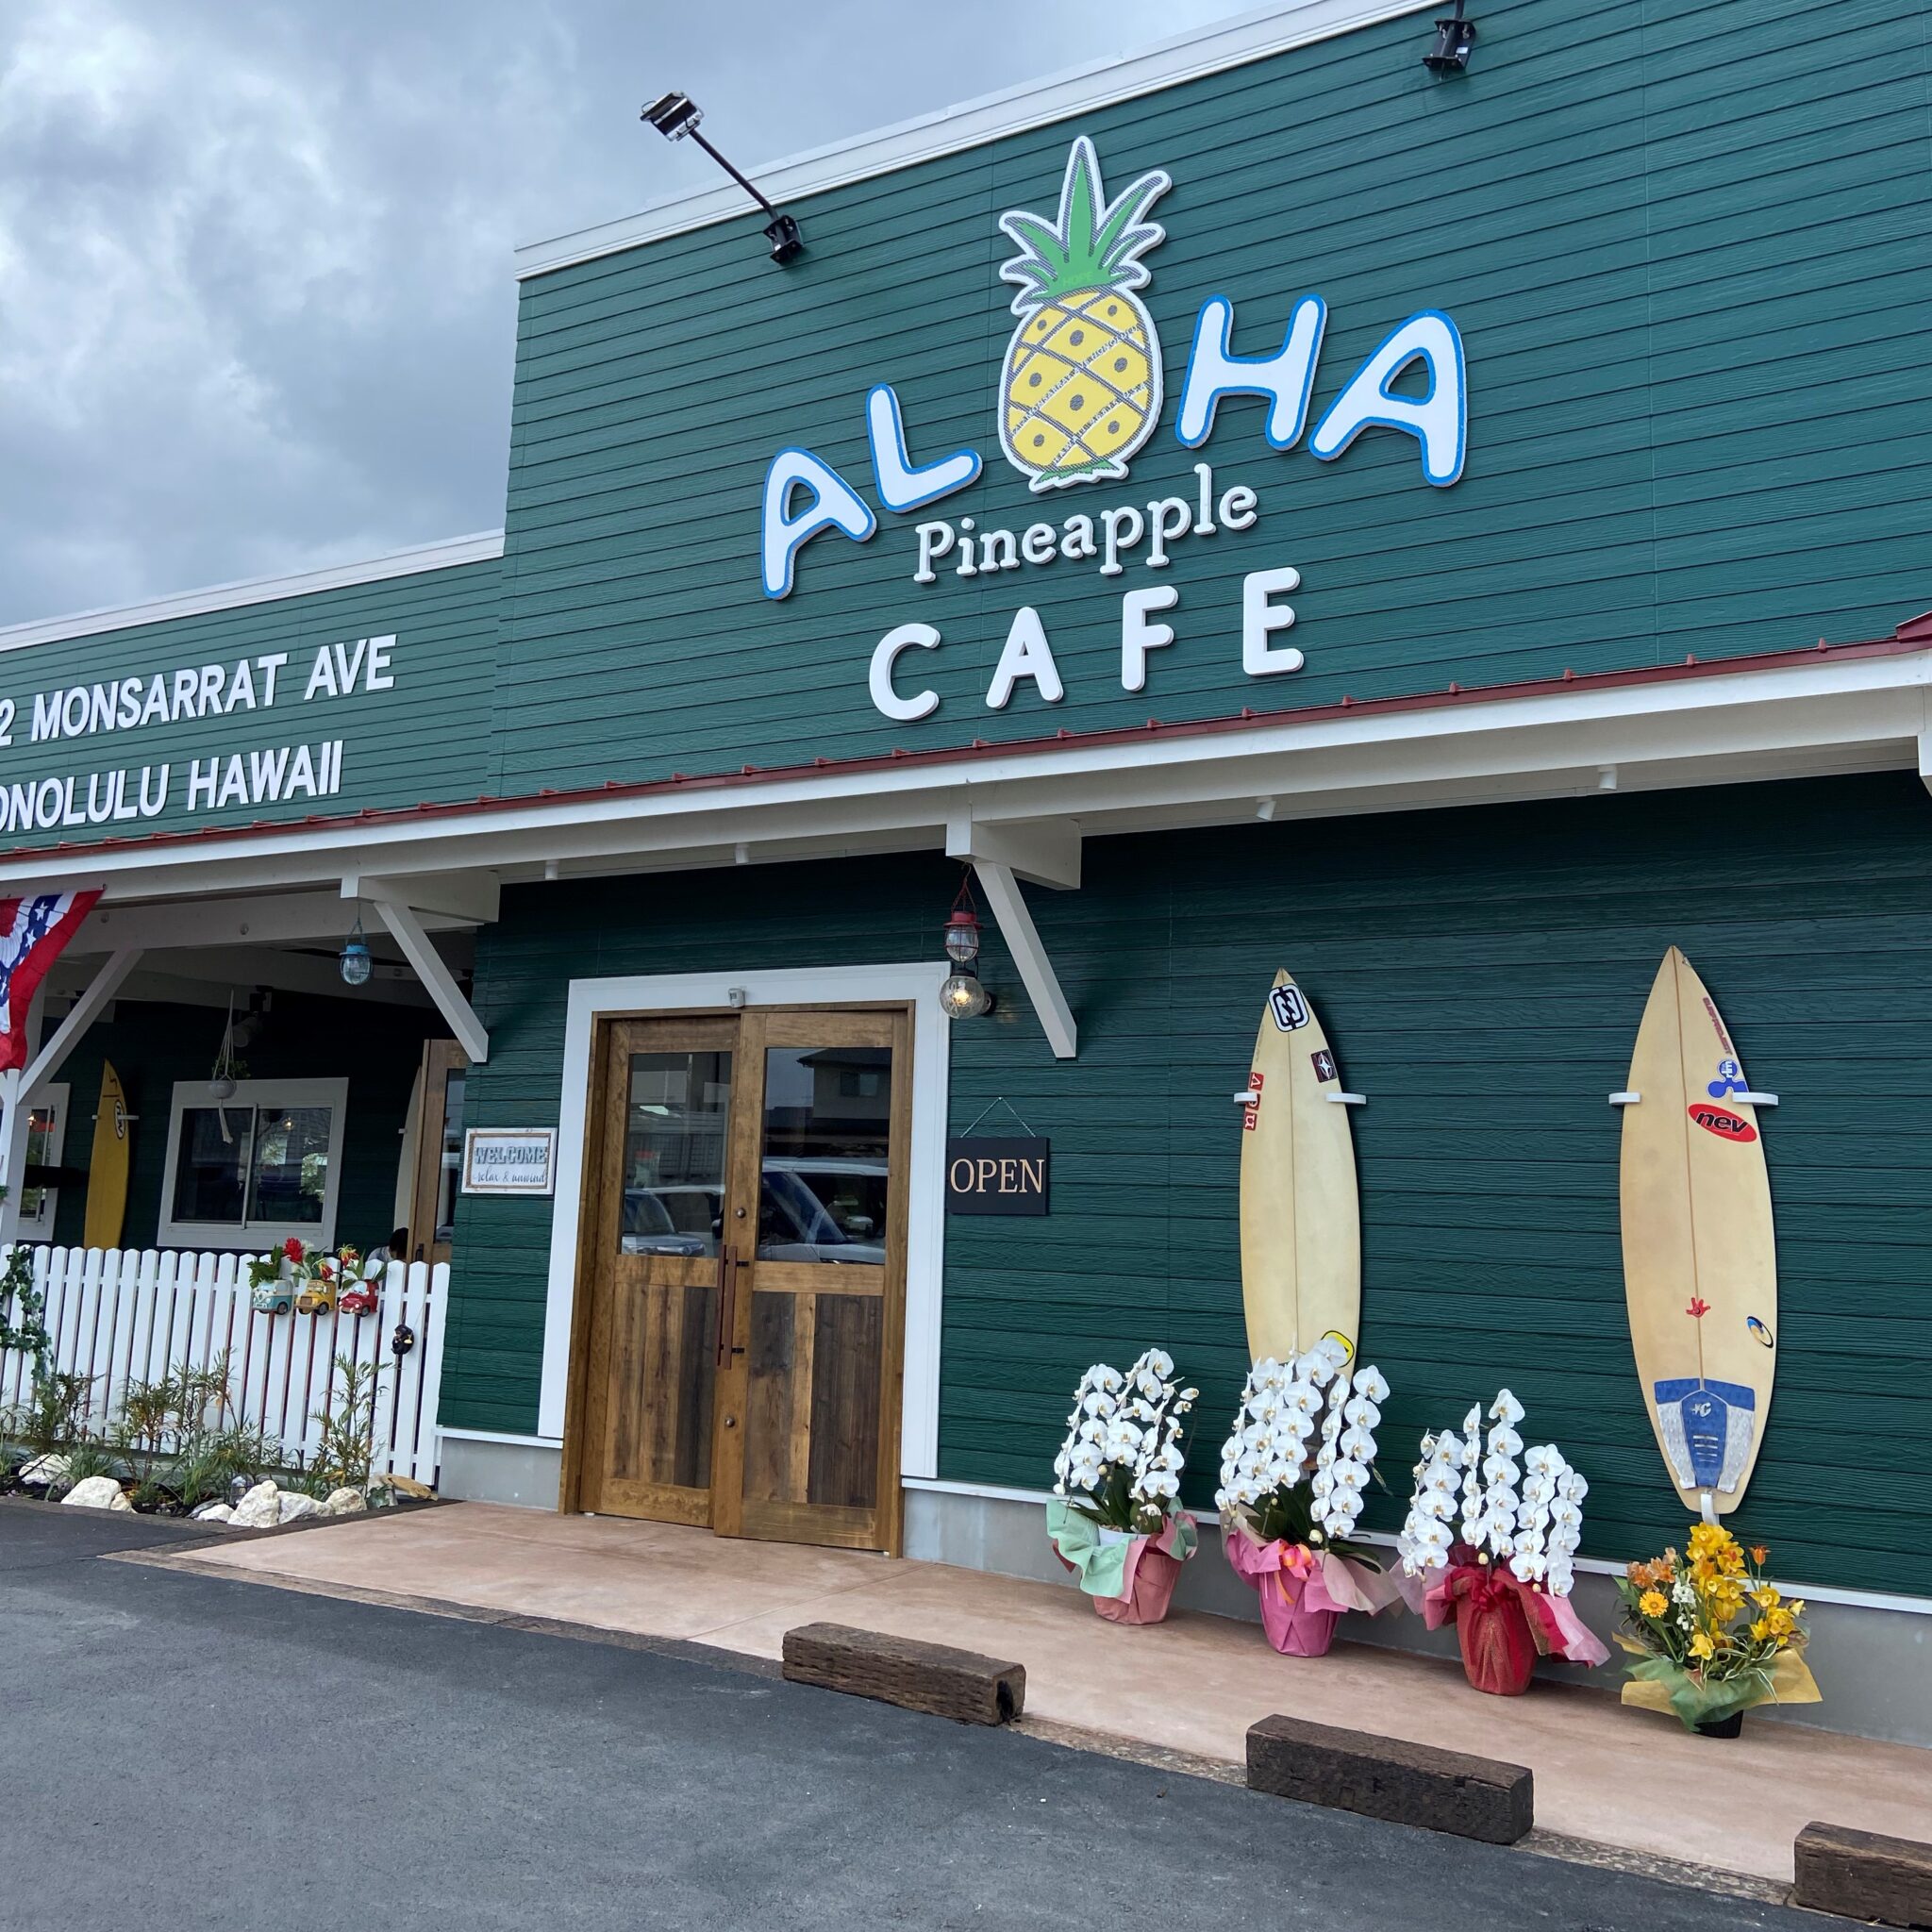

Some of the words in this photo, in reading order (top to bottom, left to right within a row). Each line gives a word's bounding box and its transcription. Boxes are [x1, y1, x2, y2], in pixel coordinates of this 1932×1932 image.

[913, 463, 1257, 582] Pineapple
[869, 567, 1304, 721] CAFE
[31, 653, 289, 741] MONSARRAT
[304, 634, 397, 701] AVE
[188, 740, 343, 811] HAWAII
[475, 1146, 548, 1164] WELCOME
[1696, 1112, 1748, 1133] nev
[950, 1158, 1044, 1193] OPEN
